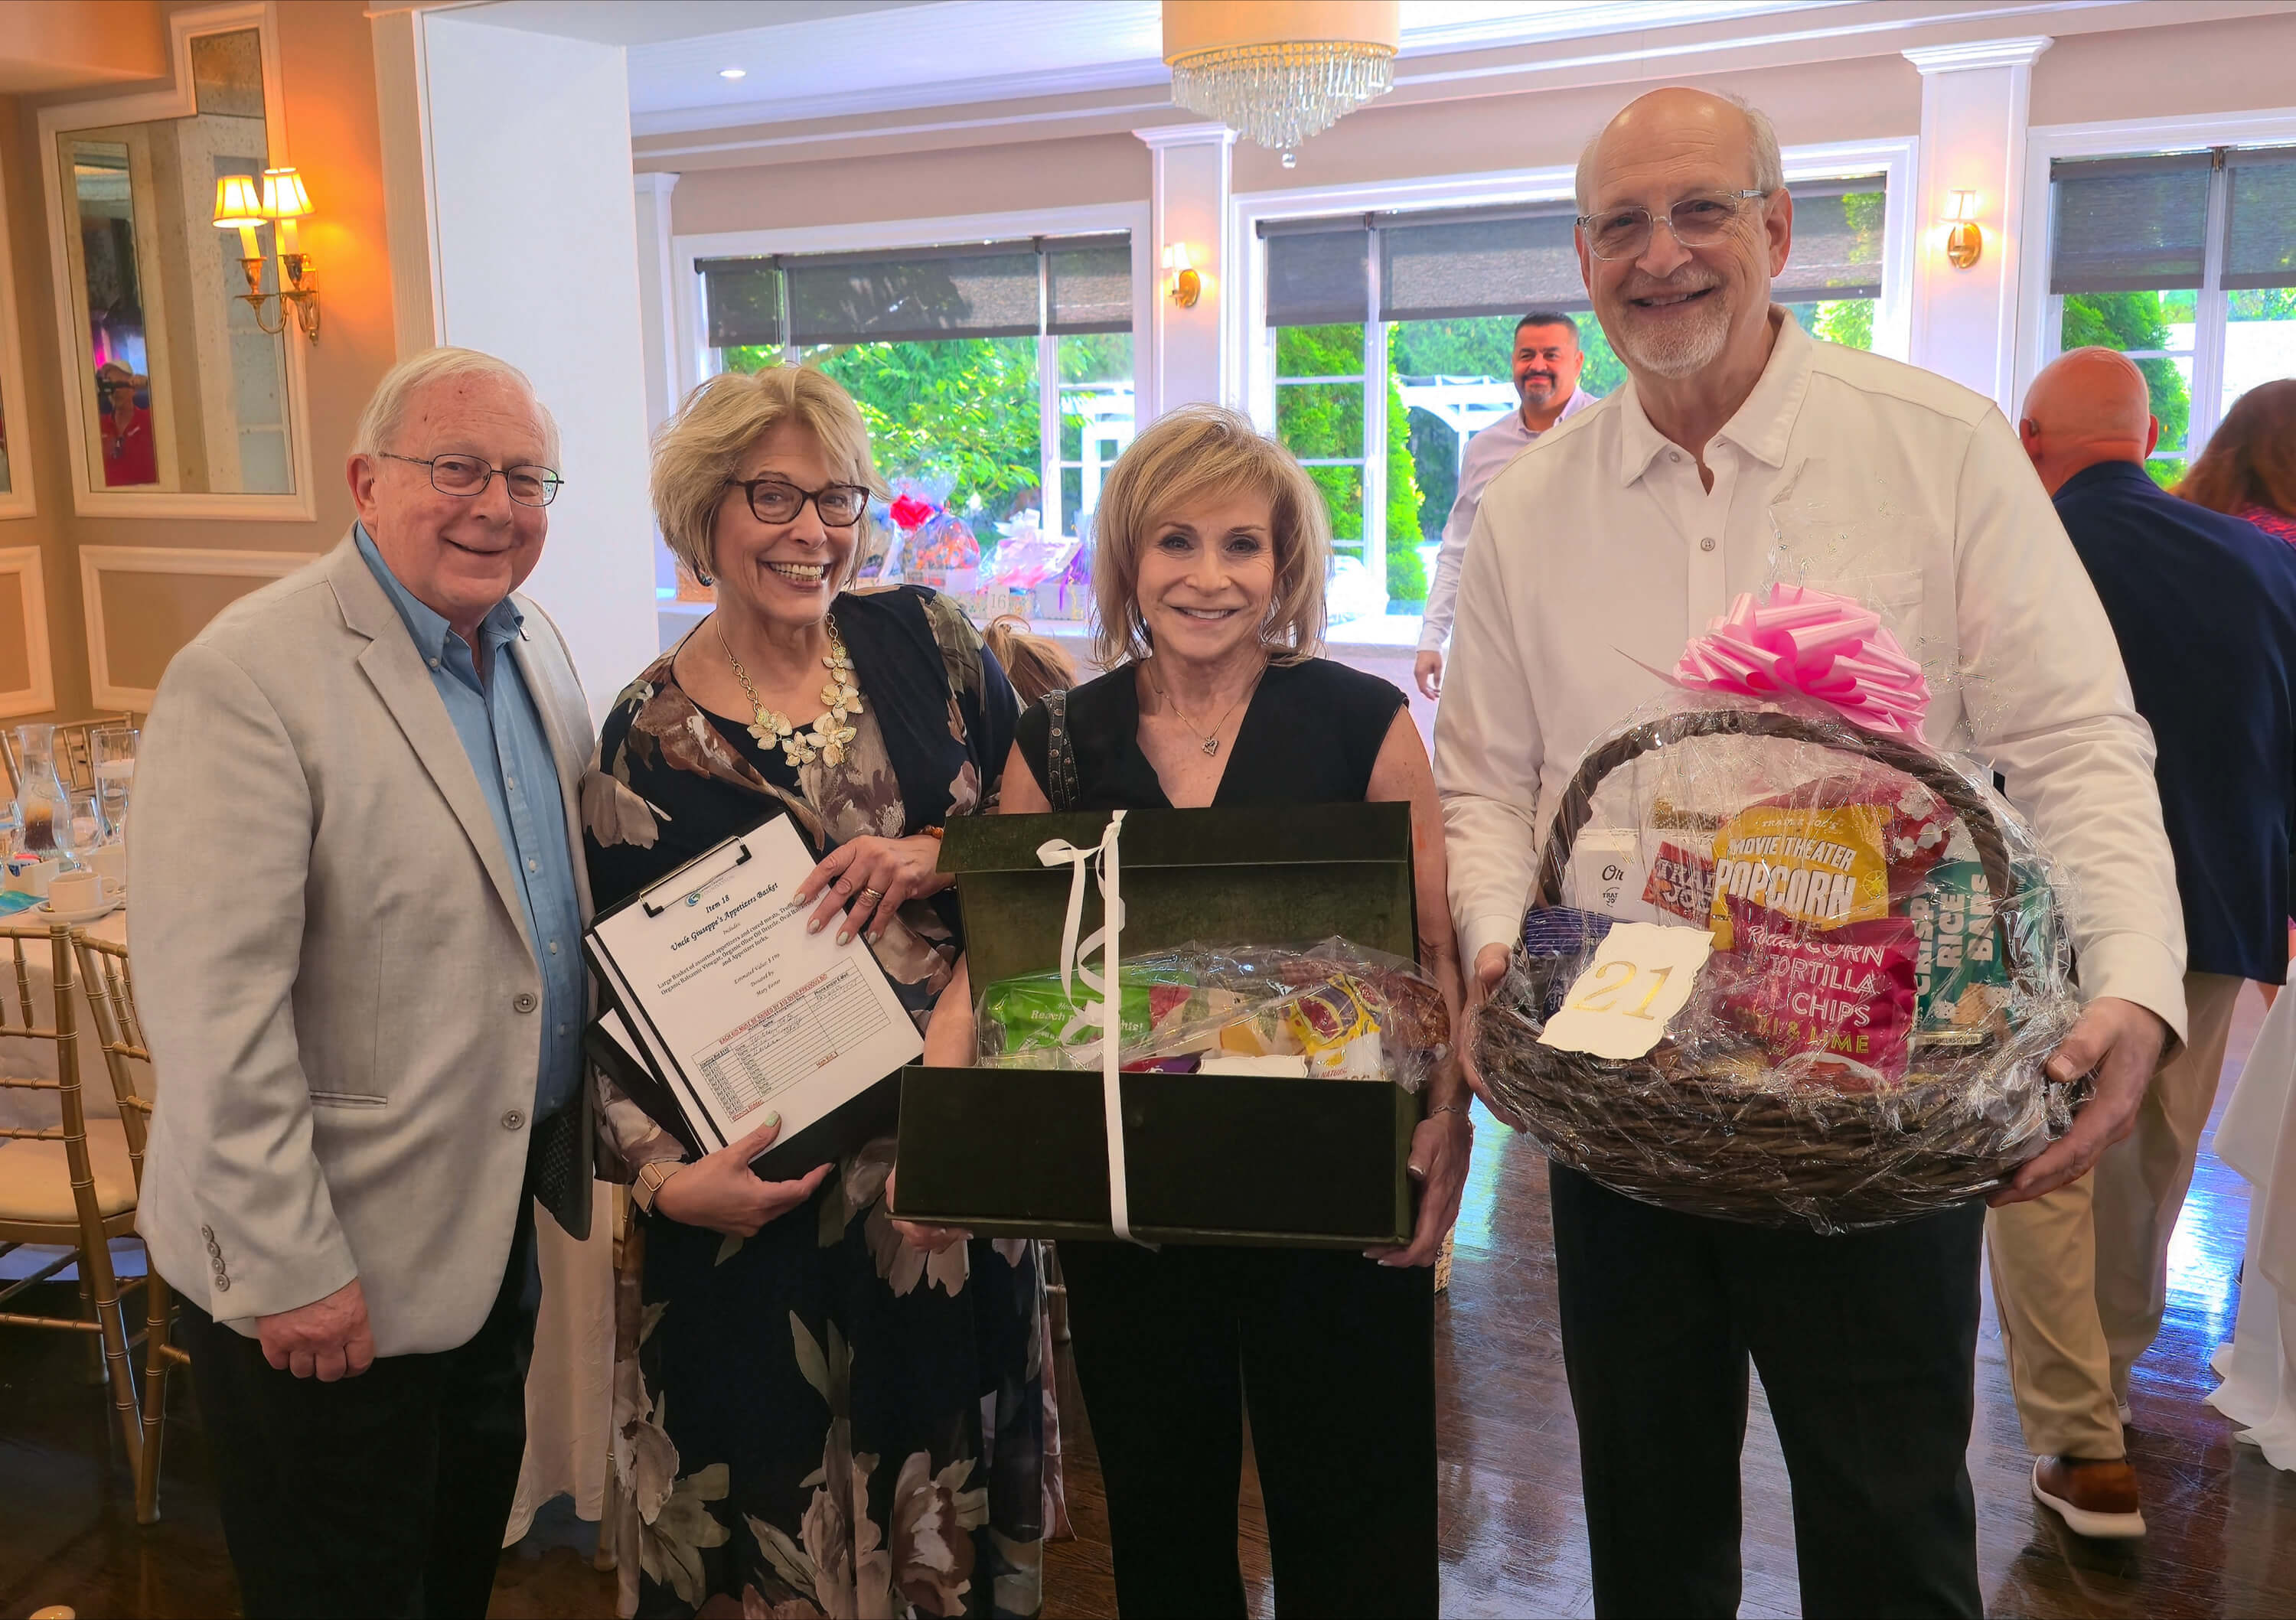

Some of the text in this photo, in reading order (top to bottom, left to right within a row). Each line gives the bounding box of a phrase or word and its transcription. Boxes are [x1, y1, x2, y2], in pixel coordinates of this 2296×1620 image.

[1727, 835, 1857, 872] MOVIE THEATER
[670, 935, 690, 950] Uncle
[690, 916, 723, 940] Giuseppe's
[724, 896, 756, 921] Appetizers
[756, 882, 778, 898] Basket
[705, 894, 730, 914] Item 18
[1713, 858, 1857, 921] POPCORN
[1968, 874, 1994, 962] BARS
[657, 978, 673, 989] Large
[671, 967, 690, 980] Basket
[694, 950, 716, 966] assorted
[715, 936, 740, 953] appetizers
[740, 929, 750, 938] and
[749, 920, 764, 932] cured
[660, 981, 681, 995] Organic
[680, 967, 703, 983] Balsamic
[701, 956, 723, 970] Vinegar,
[721, 944, 742, 957] Organic
[740, 936, 754, 946] Olive
[753, 930, 762, 938] Oil
[761, 920, 781, 934] Drizzle,
[779, 911, 791, 921] Oval
[722, 957, 732, 966] and
[732, 944, 755, 960] Appetizer
[1805, 943, 1887, 967] CORN
[1910, 897, 1934, 996] CRISP
[1936, 893, 1965, 967] RICE
[1573, 960, 1674, 1021] 21
[1770, 953, 1877, 995] TORTILLA
[1030, 1009, 1065, 1022] Reach
[1792, 992, 1870, 1027] CHIPS
